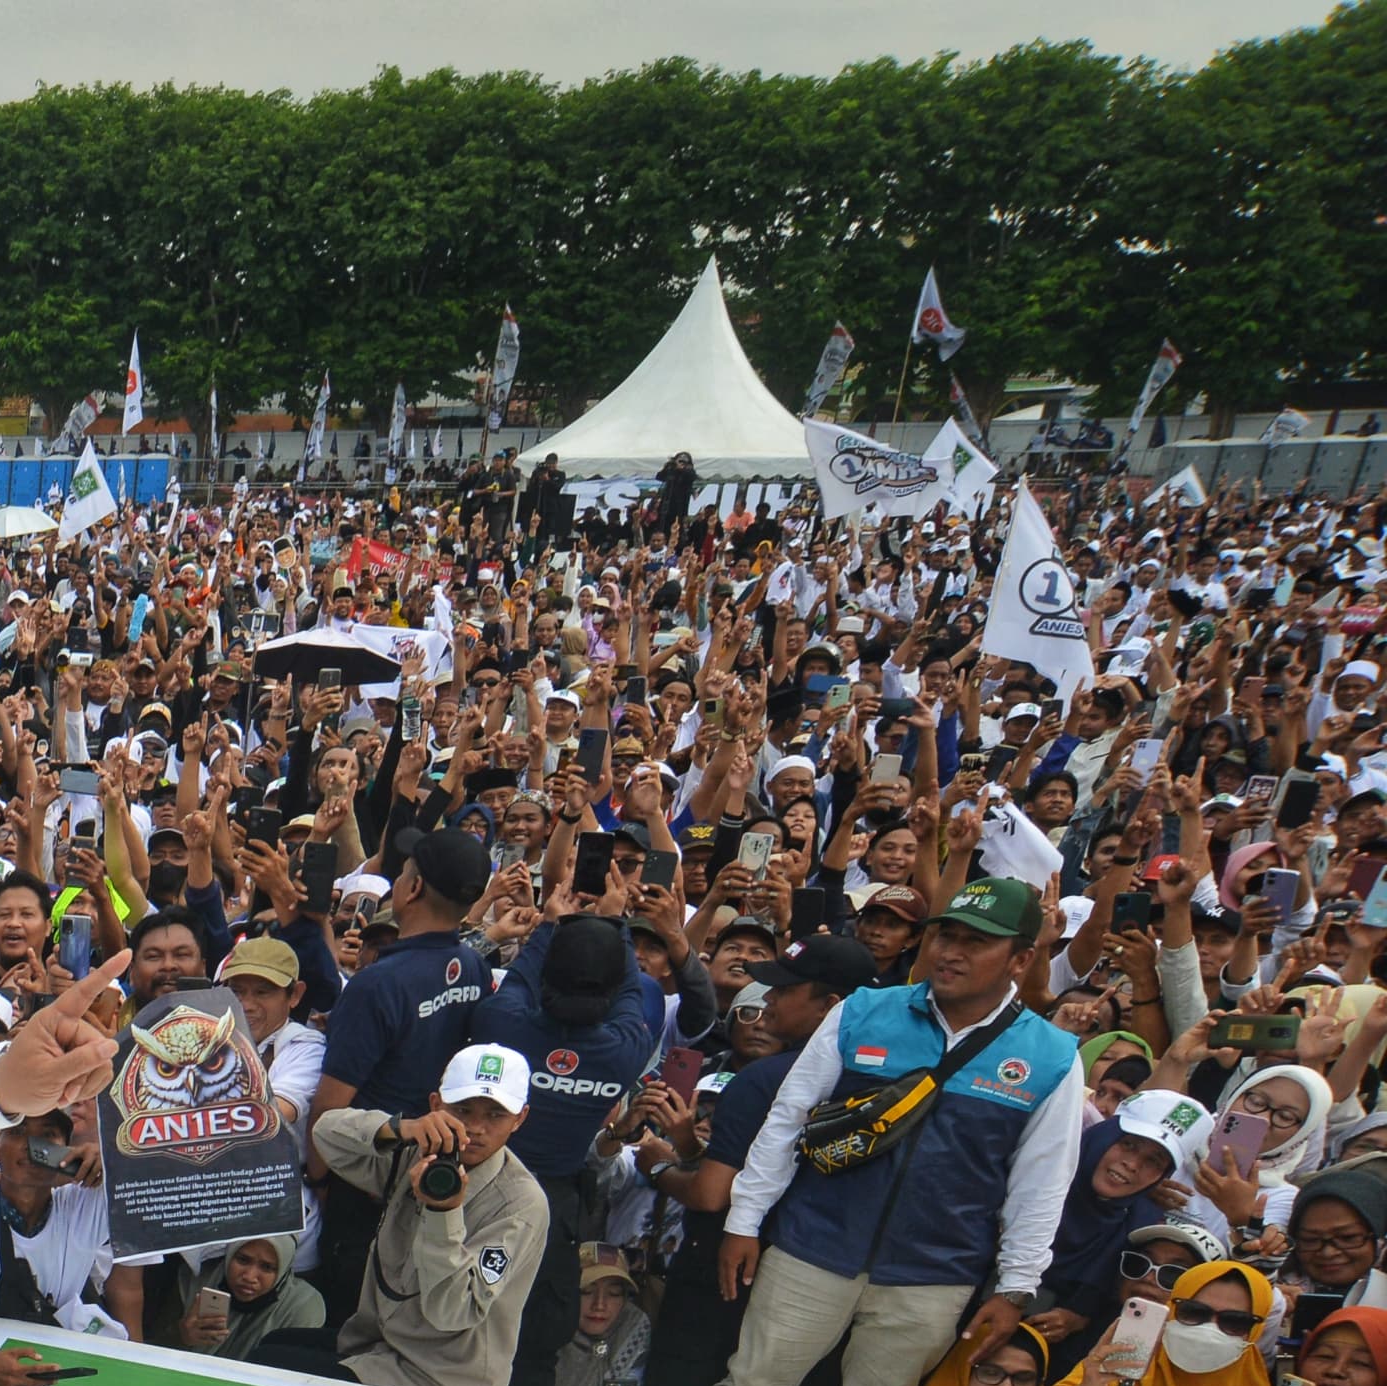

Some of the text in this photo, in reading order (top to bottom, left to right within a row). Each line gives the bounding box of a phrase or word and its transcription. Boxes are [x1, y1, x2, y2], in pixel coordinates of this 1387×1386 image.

[840, 458, 862, 478] 1
[1034, 570, 1061, 607] 1
[1037, 620, 1084, 635] ANIES
[477, 1074, 499, 1083] PKB
[530, 1072, 622, 1098] ORPIO
[138, 1105, 256, 1145] AN1ES
[1161, 1119, 1184, 1137] PKB
[220, 1168, 254, 1178] terhadap
[254, 1165, 274, 1174] Abah
[232, 1178, 251, 1187] yang
[251, 1174, 278, 1184] sampai
[278, 1171, 294, 1180] hari
[136, 1195, 149, 1205] tak
[214, 1187, 230, 1196] dari
[244, 1181, 284, 1192] demokrasi
[145, 1203, 181, 1213] kebijakan
[242, 1190, 286, 1203] pemerintah
